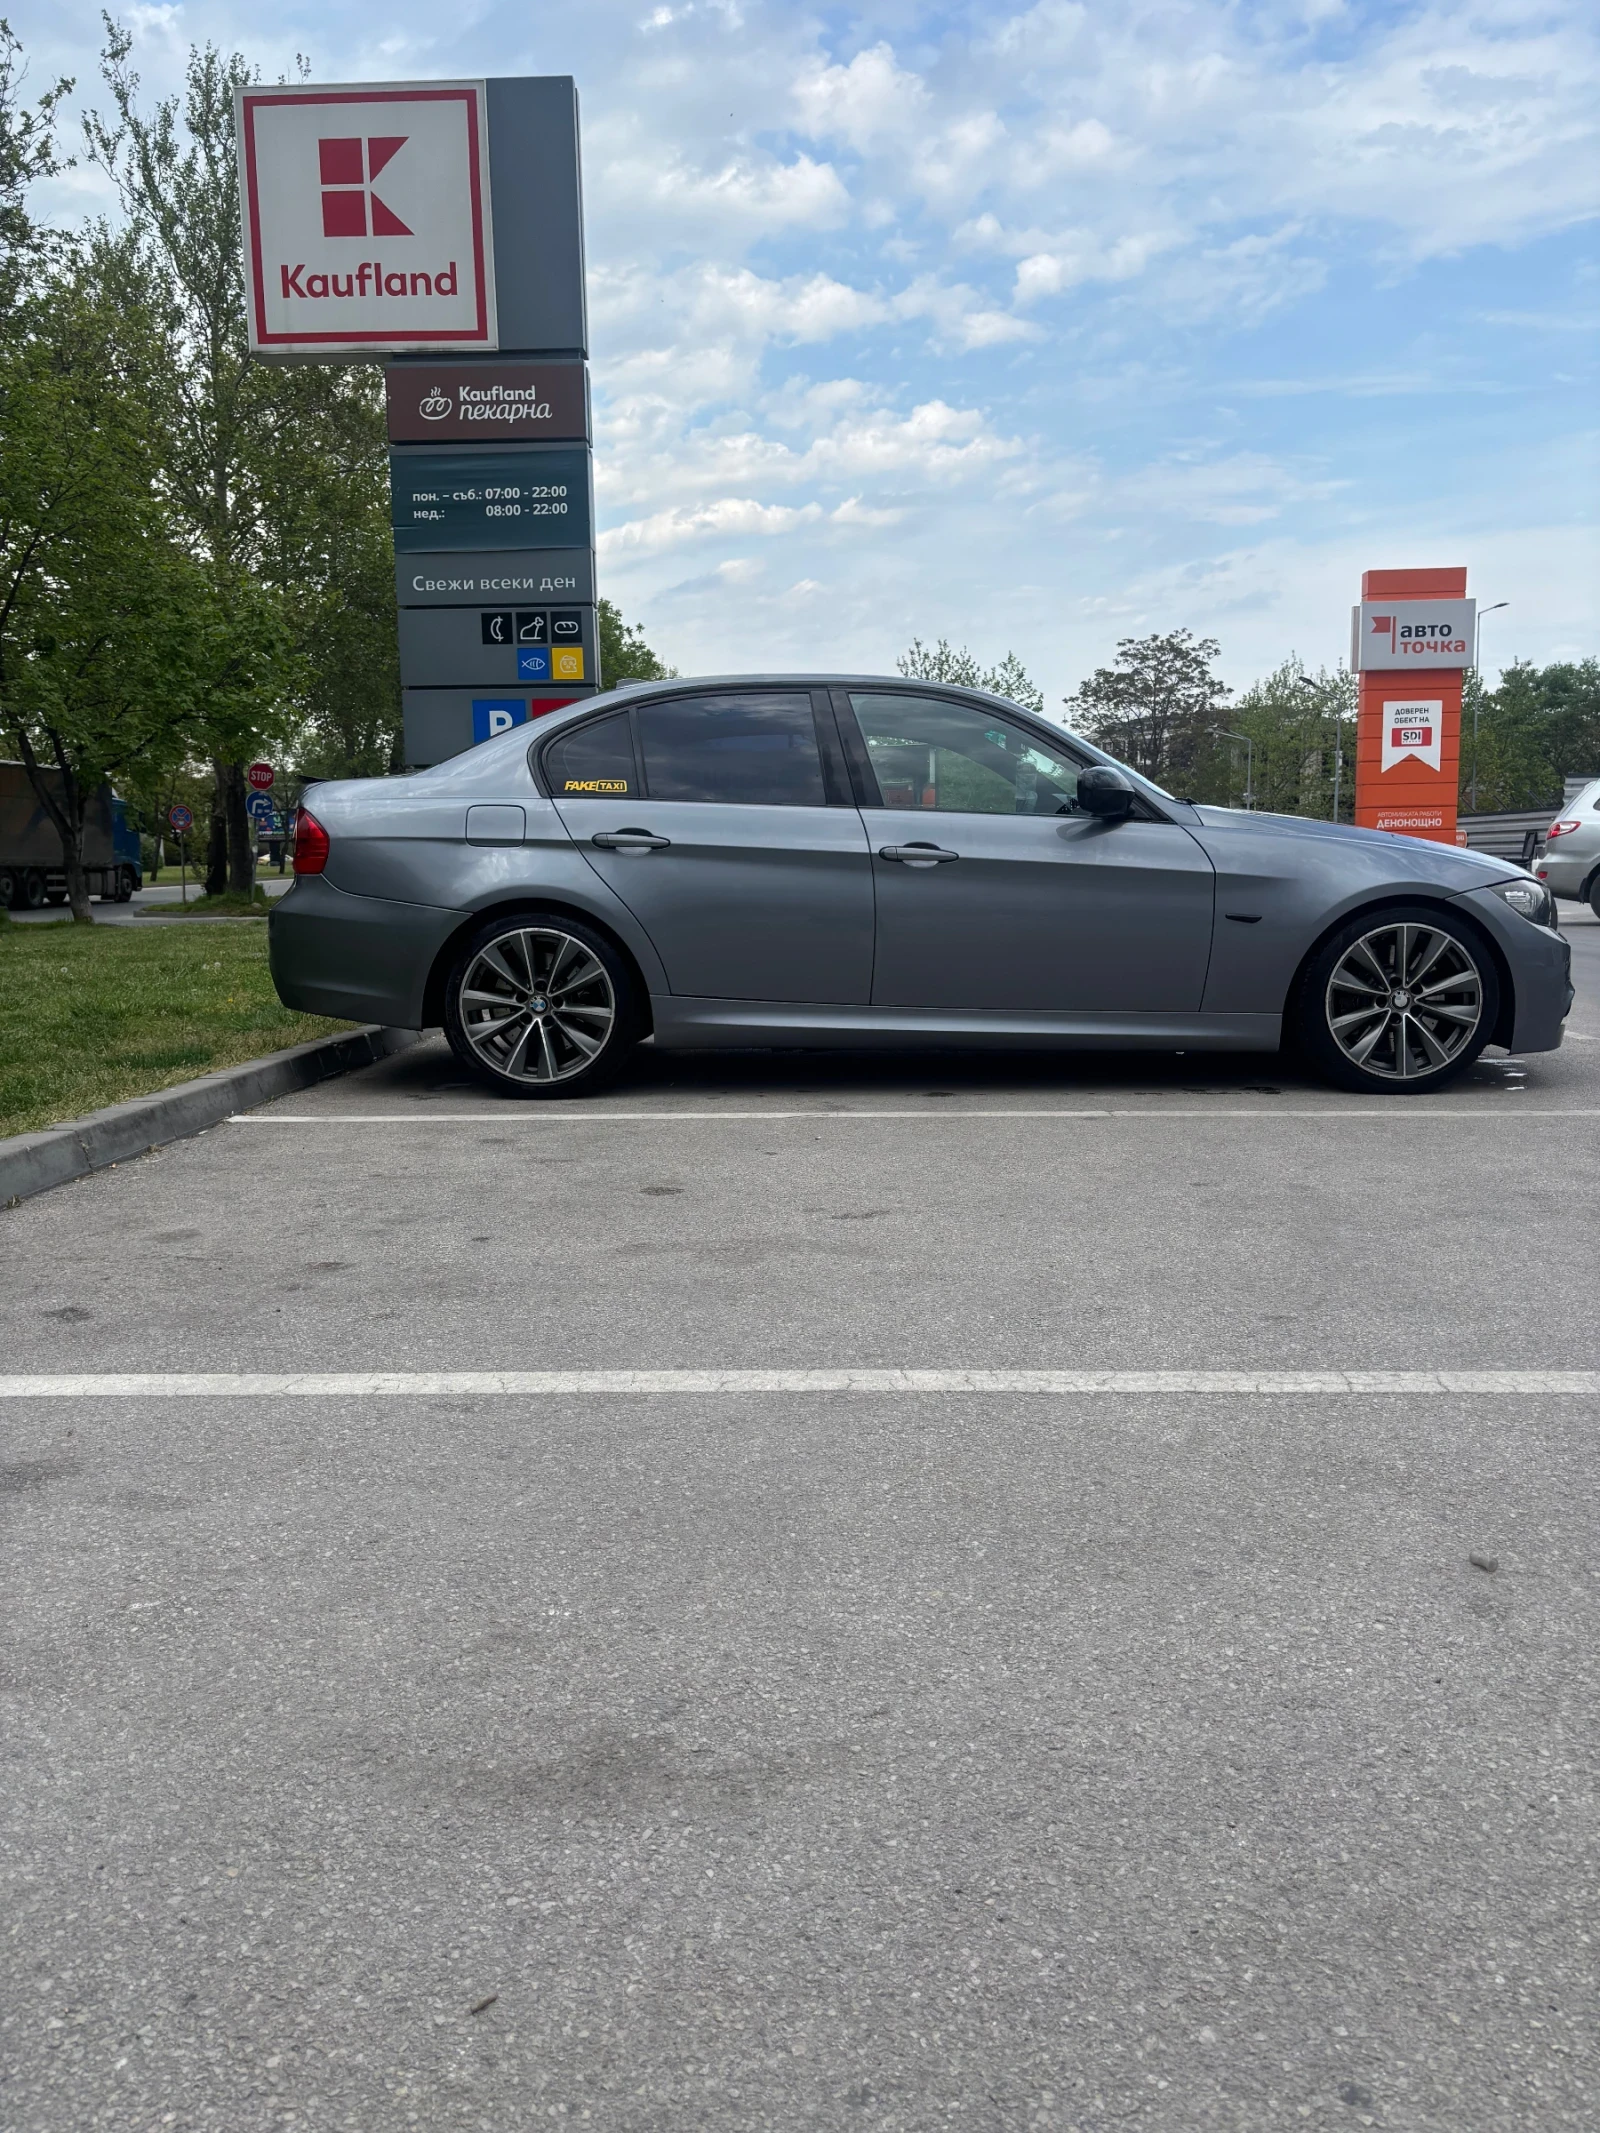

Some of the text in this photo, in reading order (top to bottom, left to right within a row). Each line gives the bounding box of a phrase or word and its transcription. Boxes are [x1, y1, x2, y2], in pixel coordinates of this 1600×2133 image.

[280, 261, 458, 299] Kaufland
[459, 385, 536, 401] Kaufland
[459, 403, 553, 424] пекарна
[412, 493, 440, 502] пон.
[452, 488, 482, 501] съб.:
[485, 487, 520, 500] 07:00
[531, 486, 567, 498] 22:00
[413, 509, 445, 520] нед.:
[485, 504, 521, 517] 08:00
[533, 503, 568, 515] 22:00
[412, 575, 576, 592] Свежи всеки ден
[1400, 624, 1453, 638] авто
[1400, 639, 1466, 655] точка
[1394, 707, 1430, 716] ДОВЕРЕН
[489, 710, 513, 737] P
[1394, 716, 1418, 724] ОБЕКТ
[1402, 731, 1421, 741] SDI
[250, 770, 272, 782] STOP
[564, 780, 624, 791] FAKE TAXI
[1376, 818, 1442, 829] ДЕНОНОЩНО
